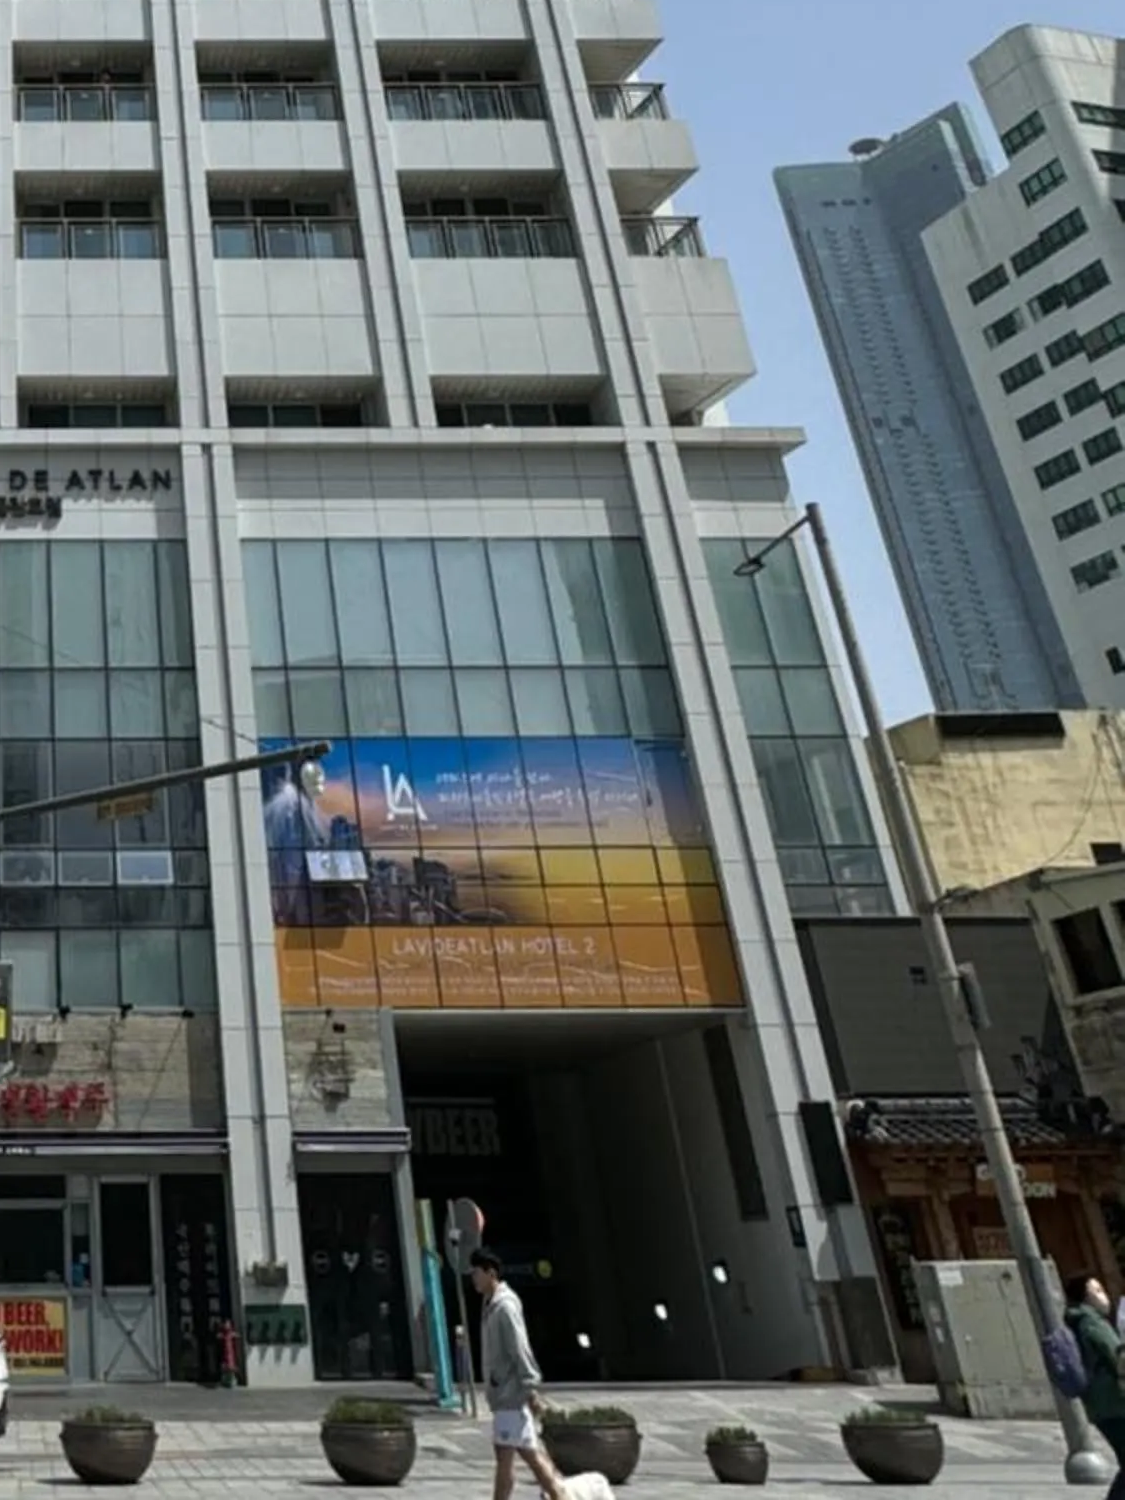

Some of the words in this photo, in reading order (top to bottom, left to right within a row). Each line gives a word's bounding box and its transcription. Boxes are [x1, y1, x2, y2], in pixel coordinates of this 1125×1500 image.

[9, 469, 49, 491] DE
[65, 469, 171, 491] ATLAN
[522, 936, 579, 956] HOTEL
